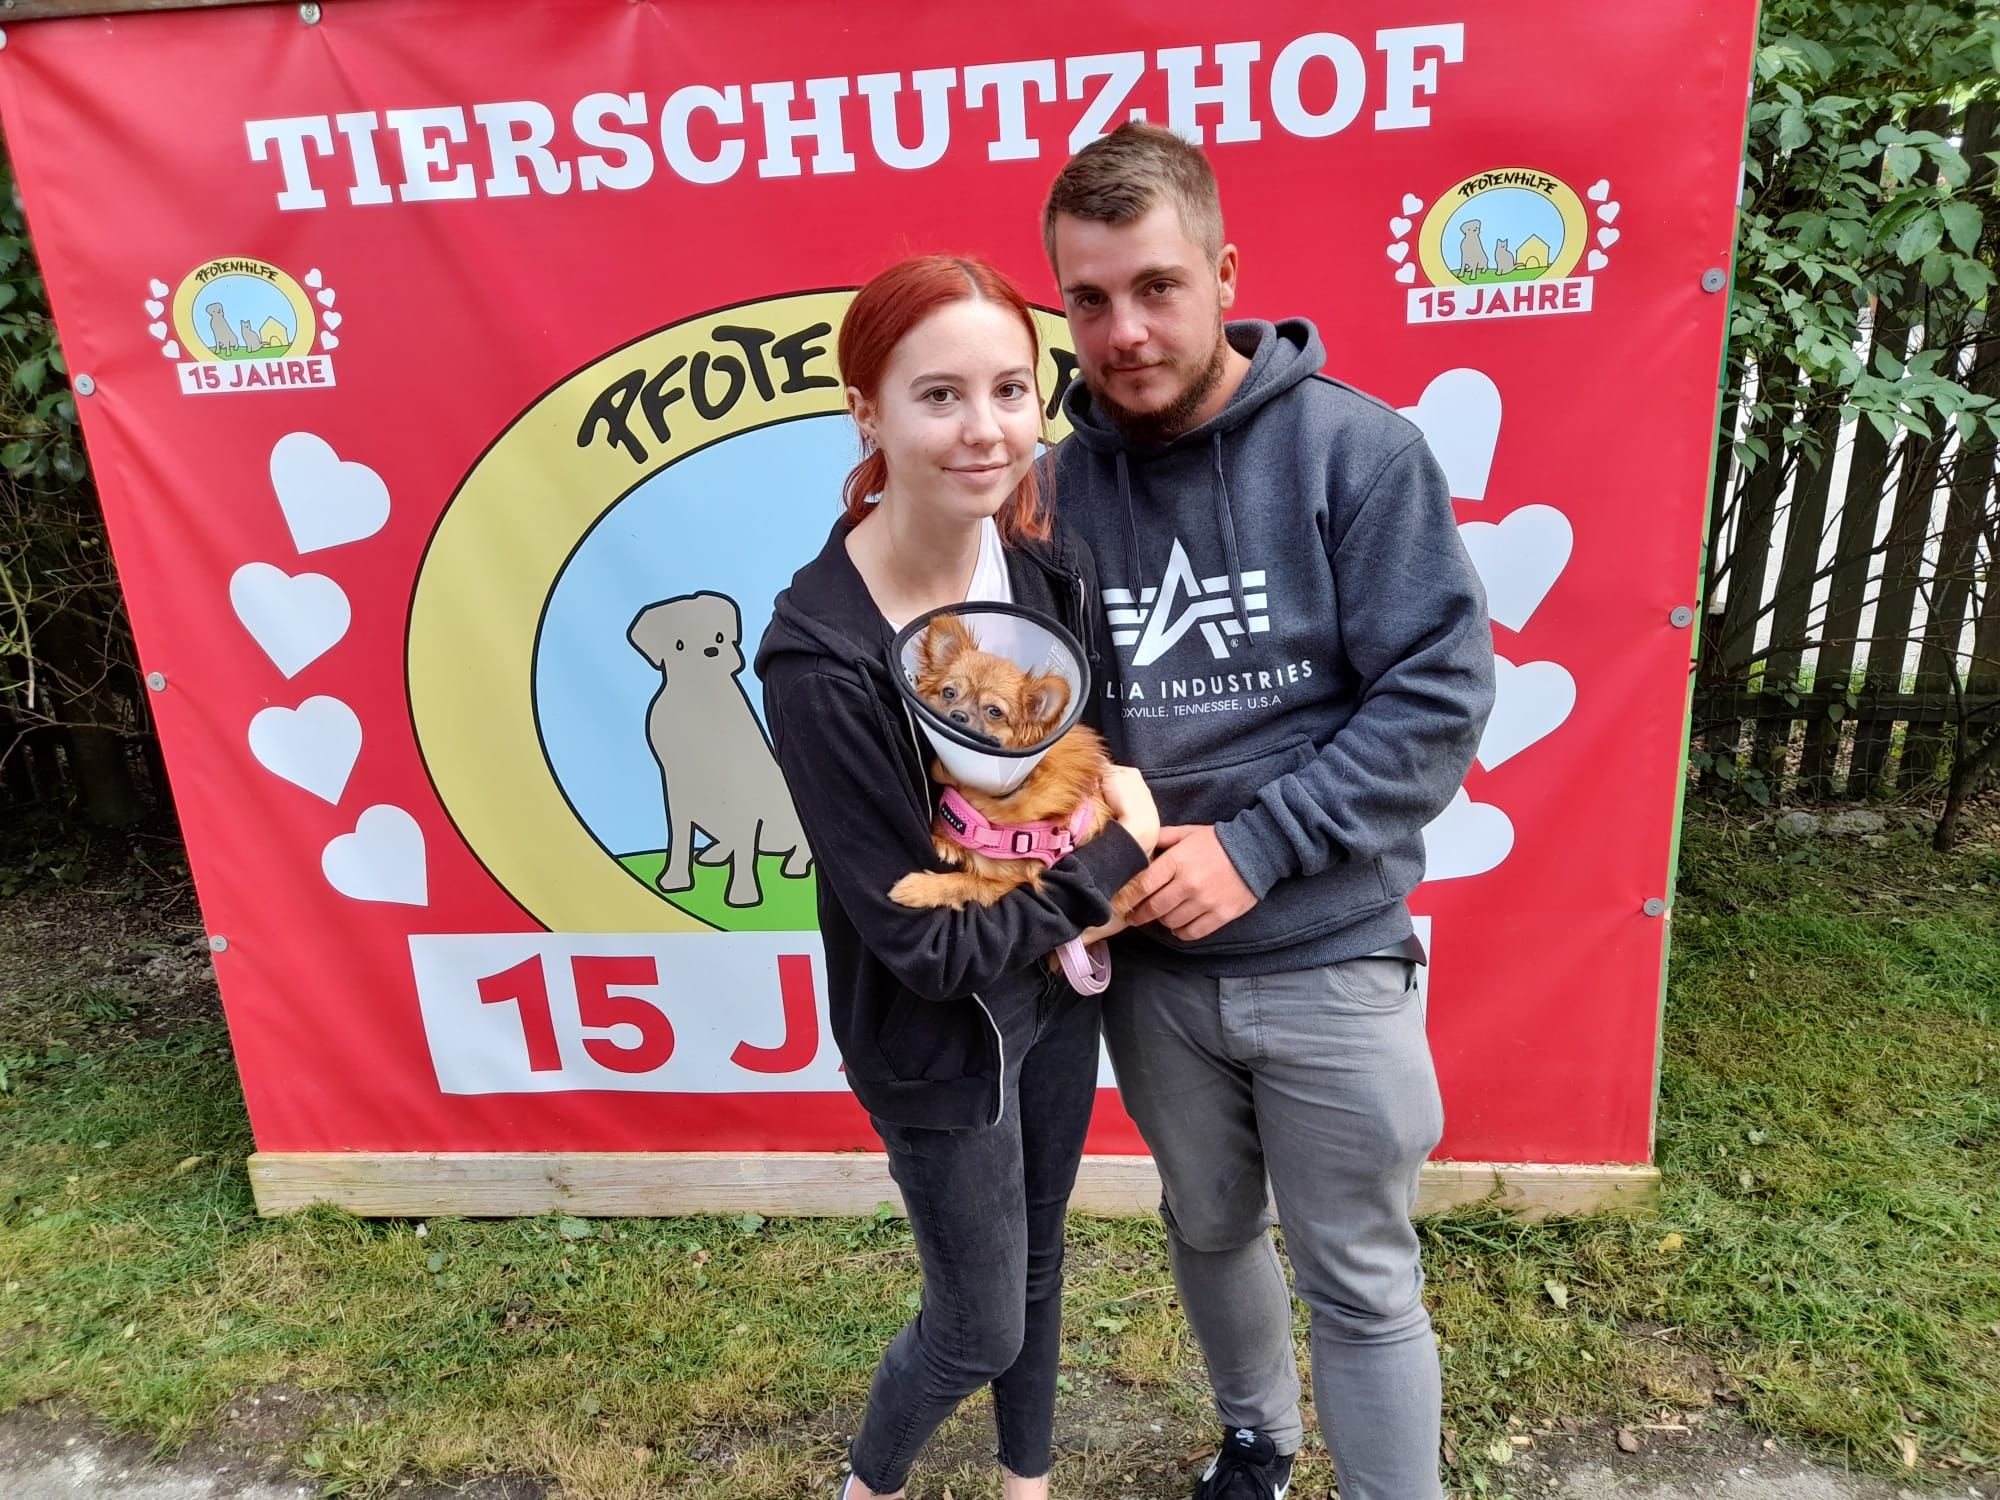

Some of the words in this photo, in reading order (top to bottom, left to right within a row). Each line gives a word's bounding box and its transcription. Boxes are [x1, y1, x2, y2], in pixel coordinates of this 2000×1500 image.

[246, 23, 1464, 211] TIERSCHUTZHOF
[1418, 291, 1456, 318] 15
[1465, 282, 1582, 316] JAHRE
[188, 366, 221, 390] 15
[230, 360, 326, 388] JAHRE
[1160, 660, 1313, 700] INDUSTRIES
[476, 953, 676, 1074] 15
